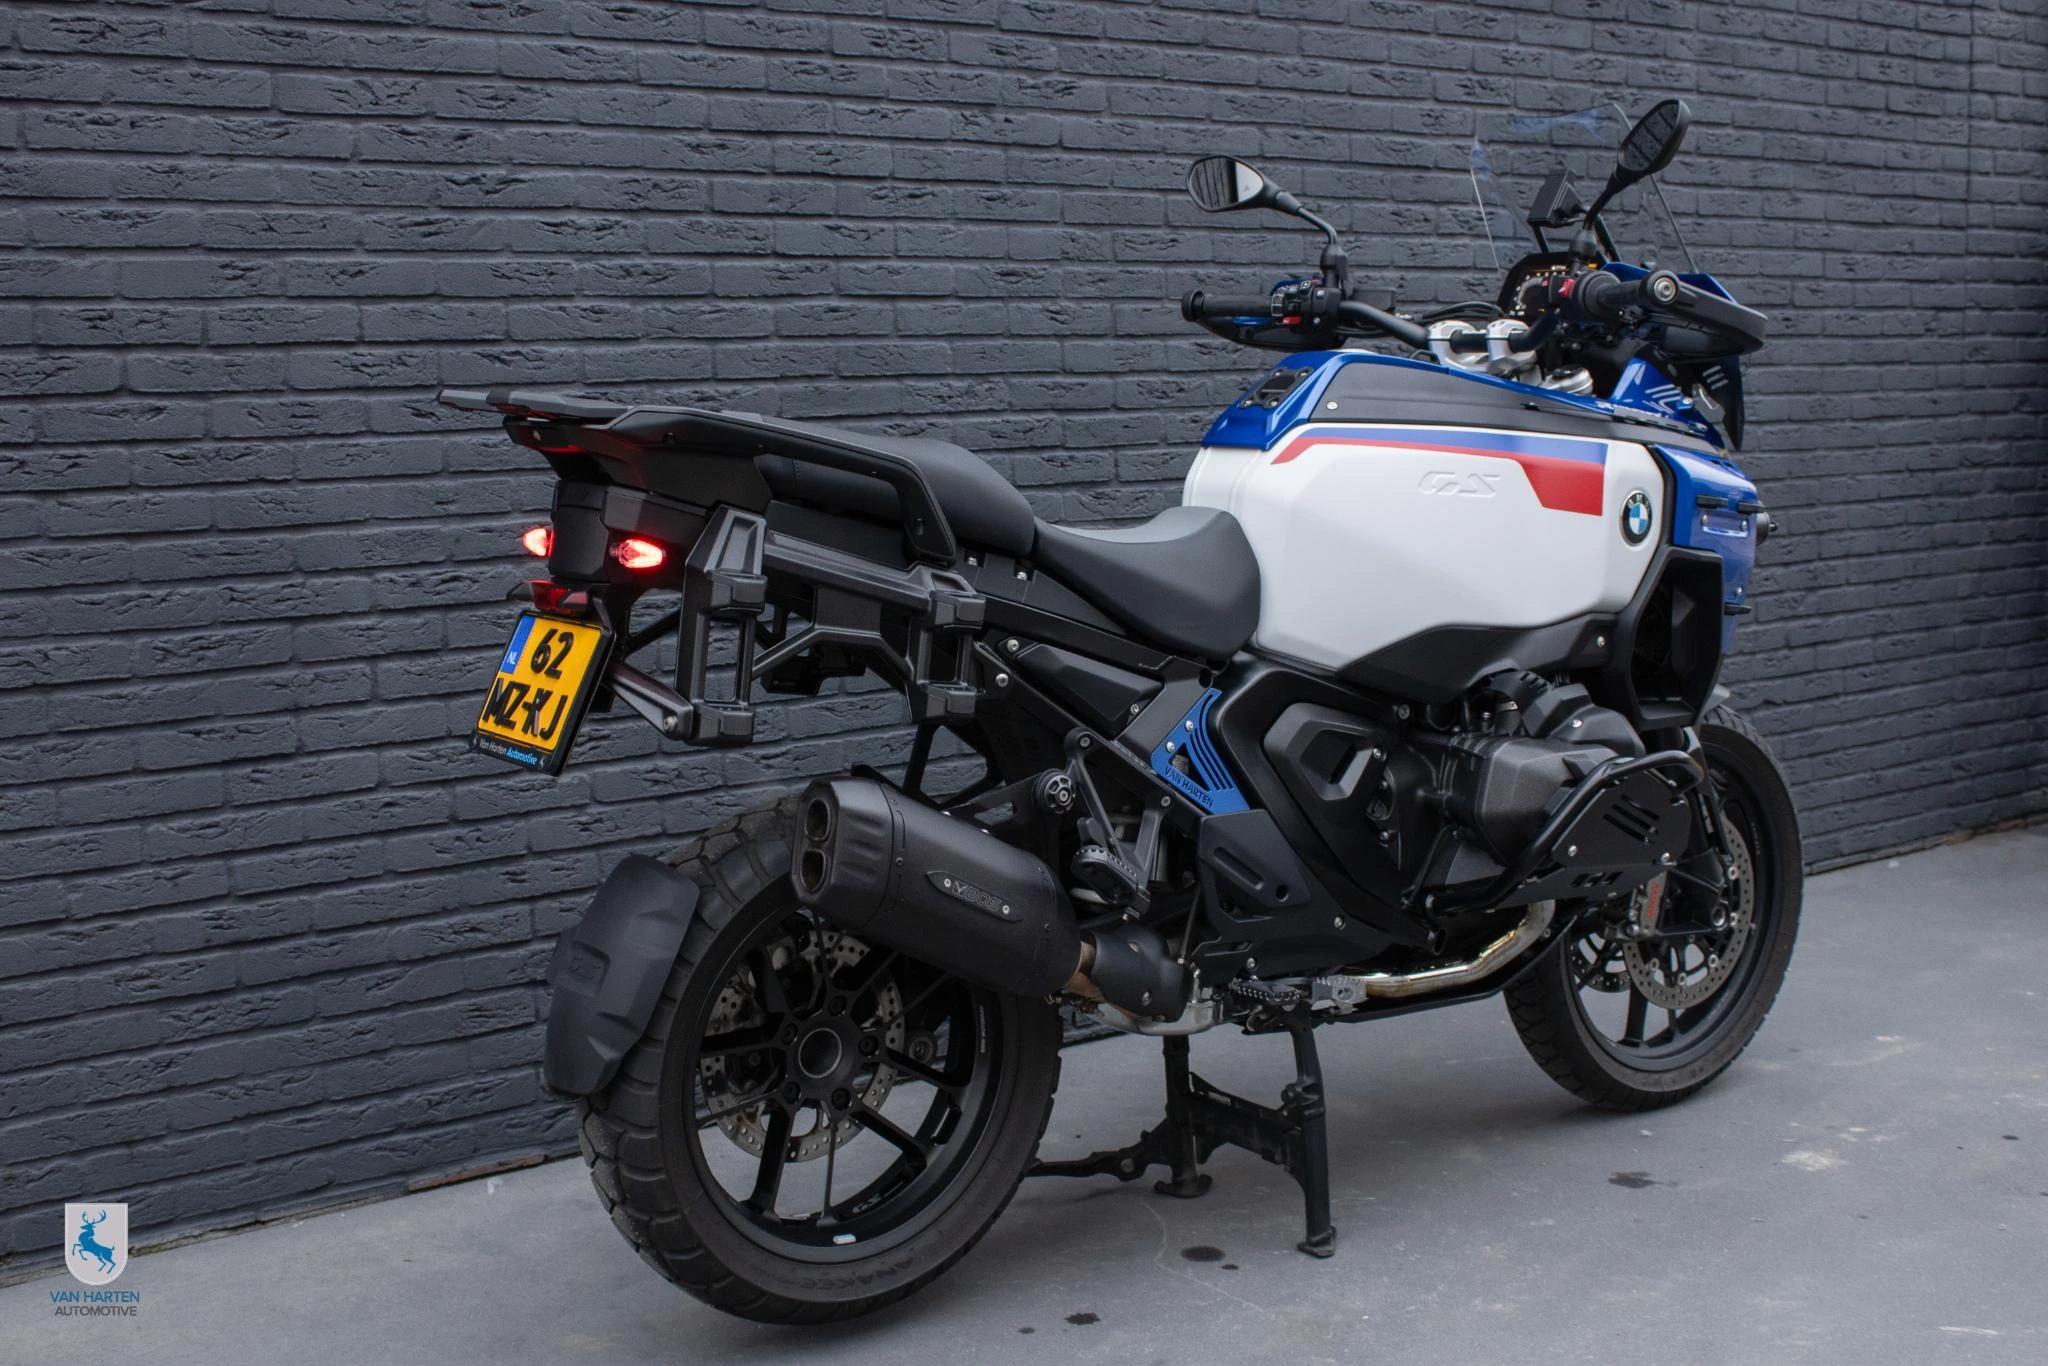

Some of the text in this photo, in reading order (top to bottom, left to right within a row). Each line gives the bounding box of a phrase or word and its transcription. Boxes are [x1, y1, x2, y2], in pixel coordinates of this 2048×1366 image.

[507, 651, 516, 665] NL
[531, 628, 574, 680] 62
[480, 738, 538, 765] Van Harten Automotive
[1165, 766, 1213, 808] VAN HARTEN
